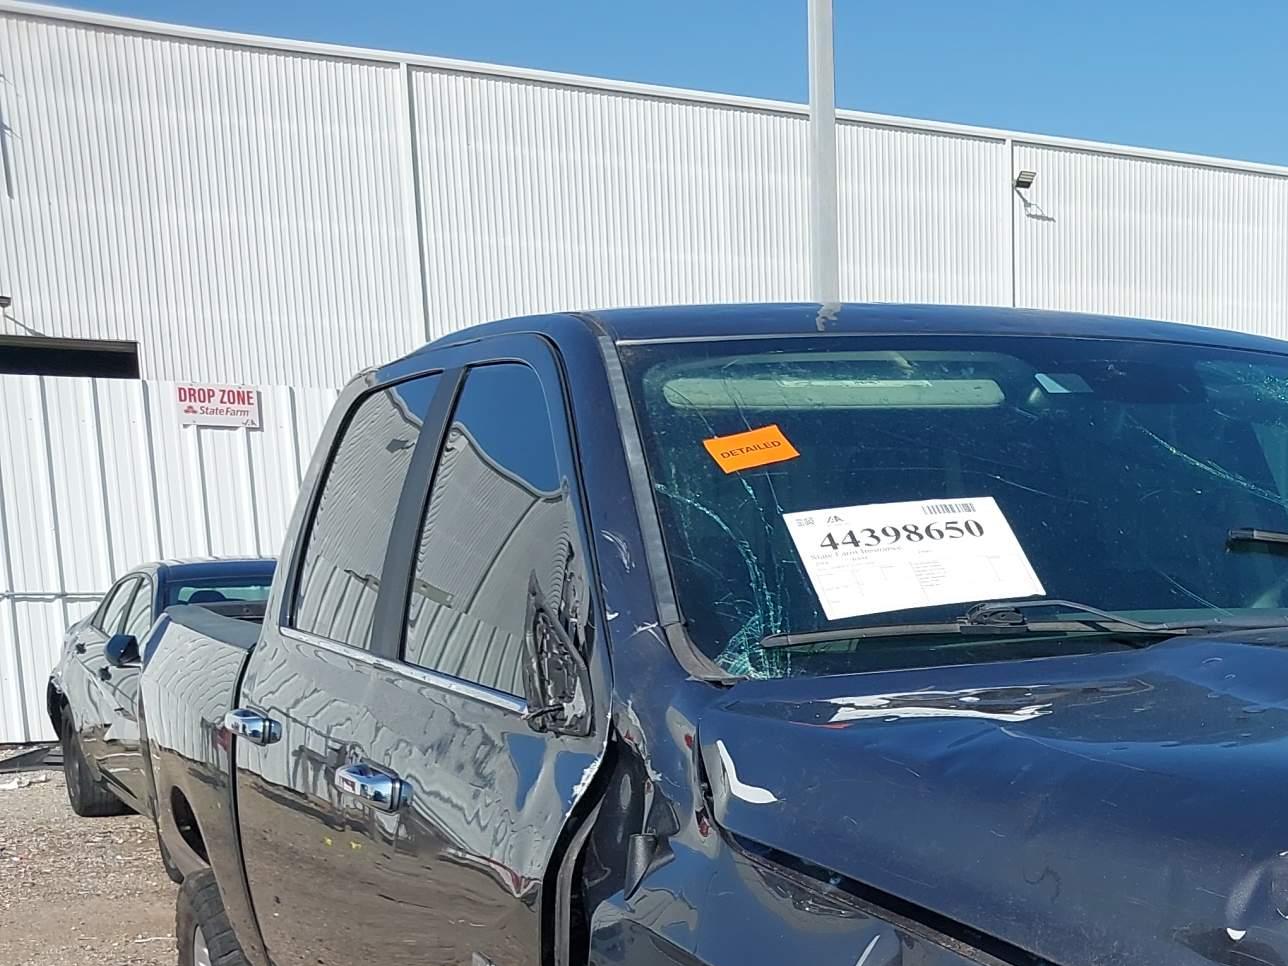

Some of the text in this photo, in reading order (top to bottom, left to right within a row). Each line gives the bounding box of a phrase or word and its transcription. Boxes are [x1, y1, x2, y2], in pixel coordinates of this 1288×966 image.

[177, 387, 254, 406] DROP ZONE
[720, 440, 782, 459] DETAILED
[819, 519, 985, 551] 44398650
